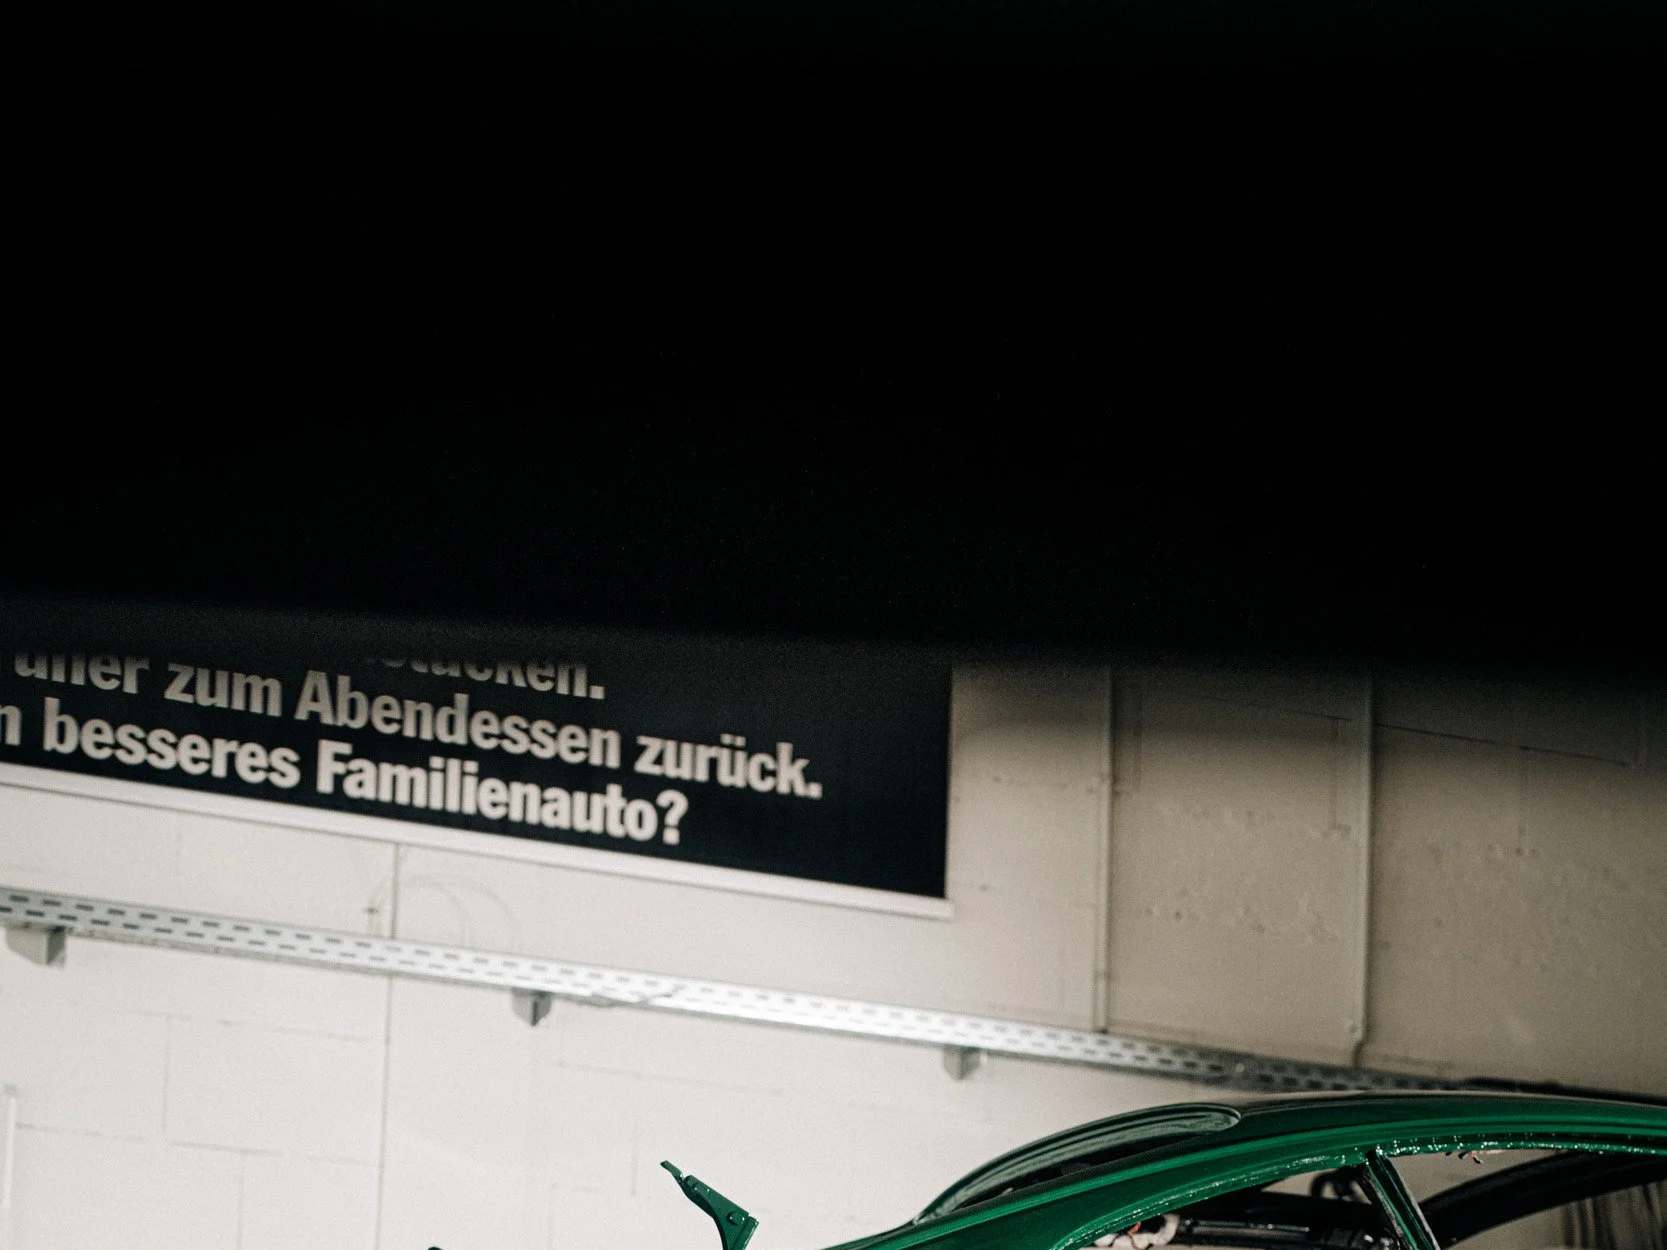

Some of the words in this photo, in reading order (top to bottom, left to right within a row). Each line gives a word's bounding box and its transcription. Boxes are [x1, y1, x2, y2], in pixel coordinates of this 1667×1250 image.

[43, 697, 300, 789] besseres
[316, 739, 689, 846] Familienauto?
[164, 662, 282, 717] zum
[295, 670, 622, 769] Abendessen
[634, 733, 823, 799] zurück.
